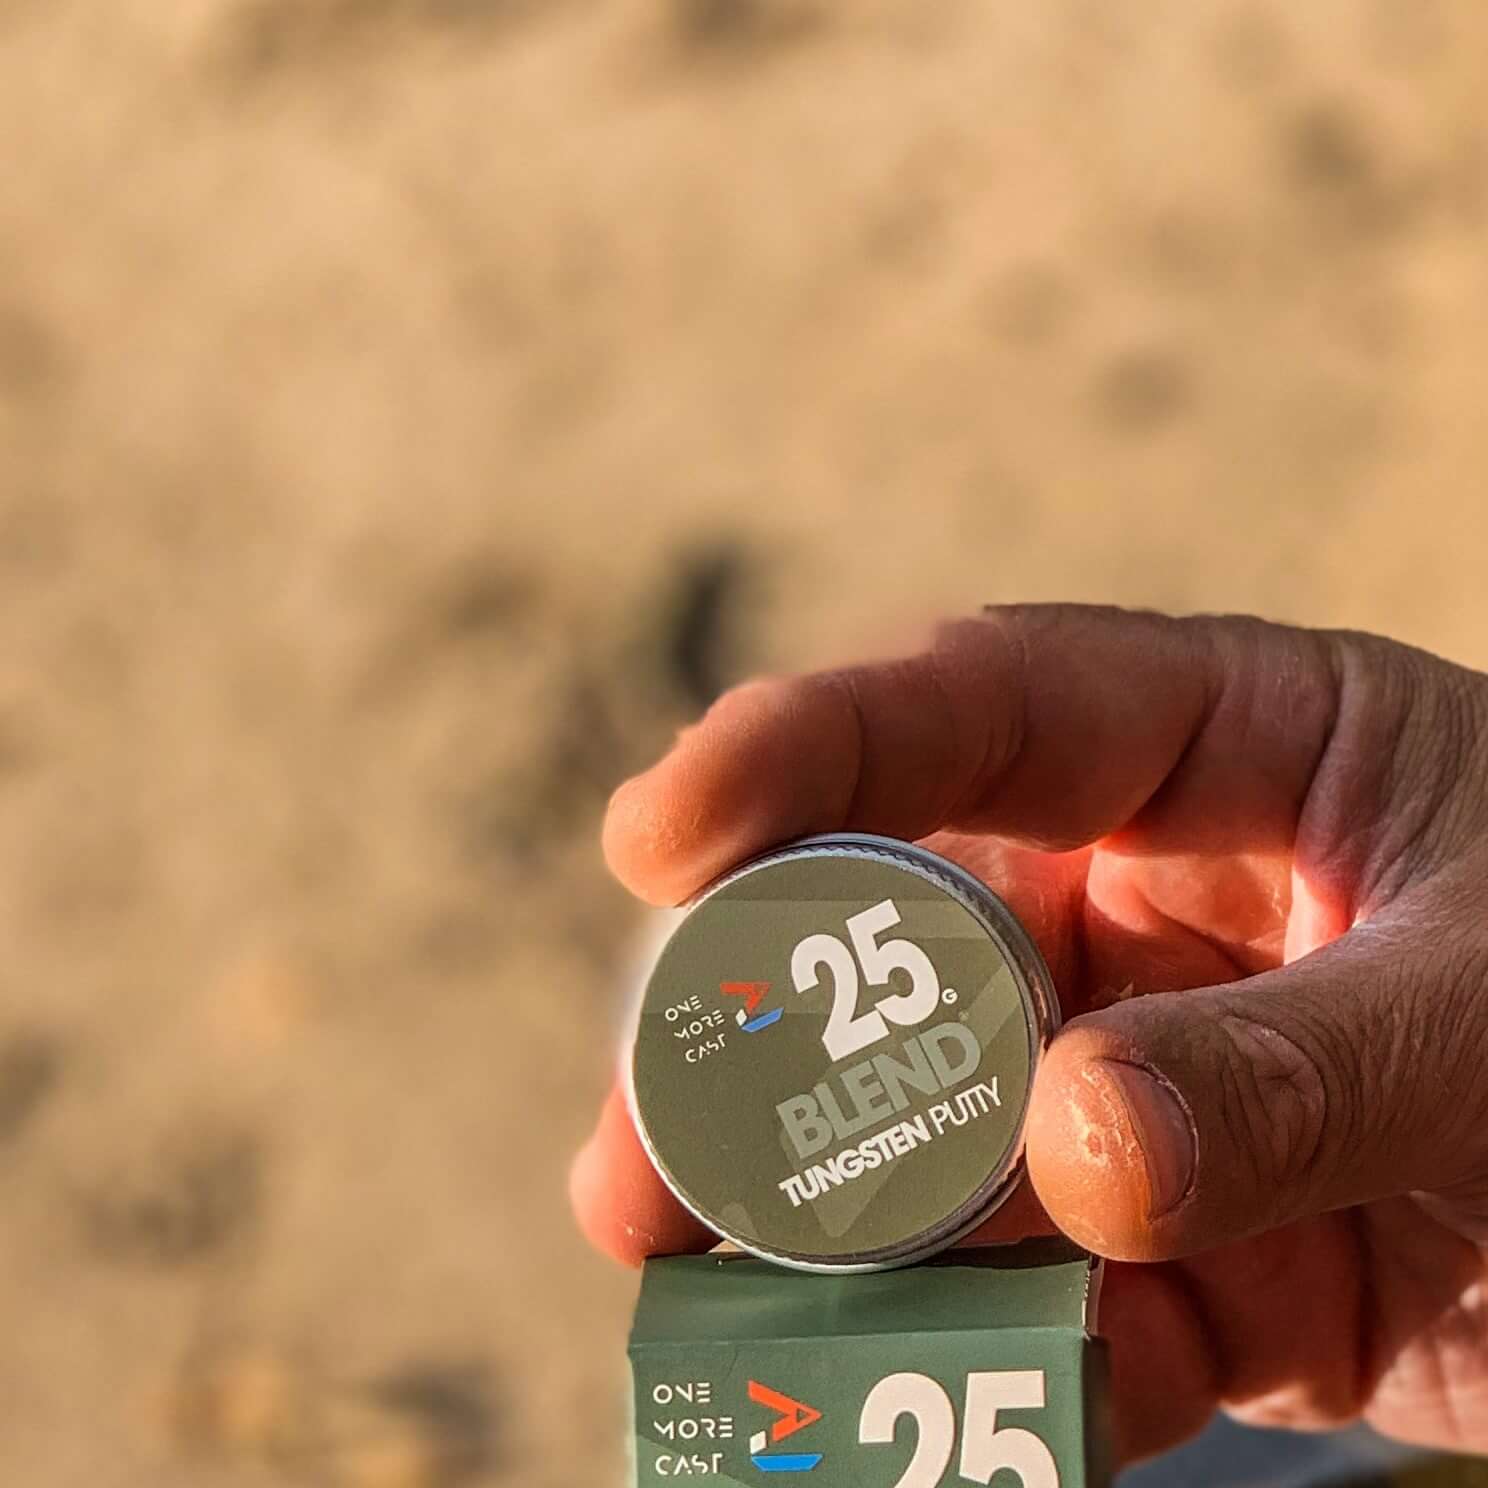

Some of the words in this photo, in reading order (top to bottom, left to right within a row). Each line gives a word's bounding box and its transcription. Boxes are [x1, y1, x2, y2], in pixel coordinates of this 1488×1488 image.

[665, 995, 702, 1023] ONE
[674, 1009, 725, 1042] MORE
[685, 1033, 728, 1063] CAST
[775, 1022, 981, 1160] BLEND
[778, 1114, 933, 1207] TUNGSTEN
[927, 1076, 1002, 1136] PUTTY
[652, 1383, 711, 1405] ONE
[653, 1417, 734, 1441] MORE
[655, 1452, 726, 1476] CAST
